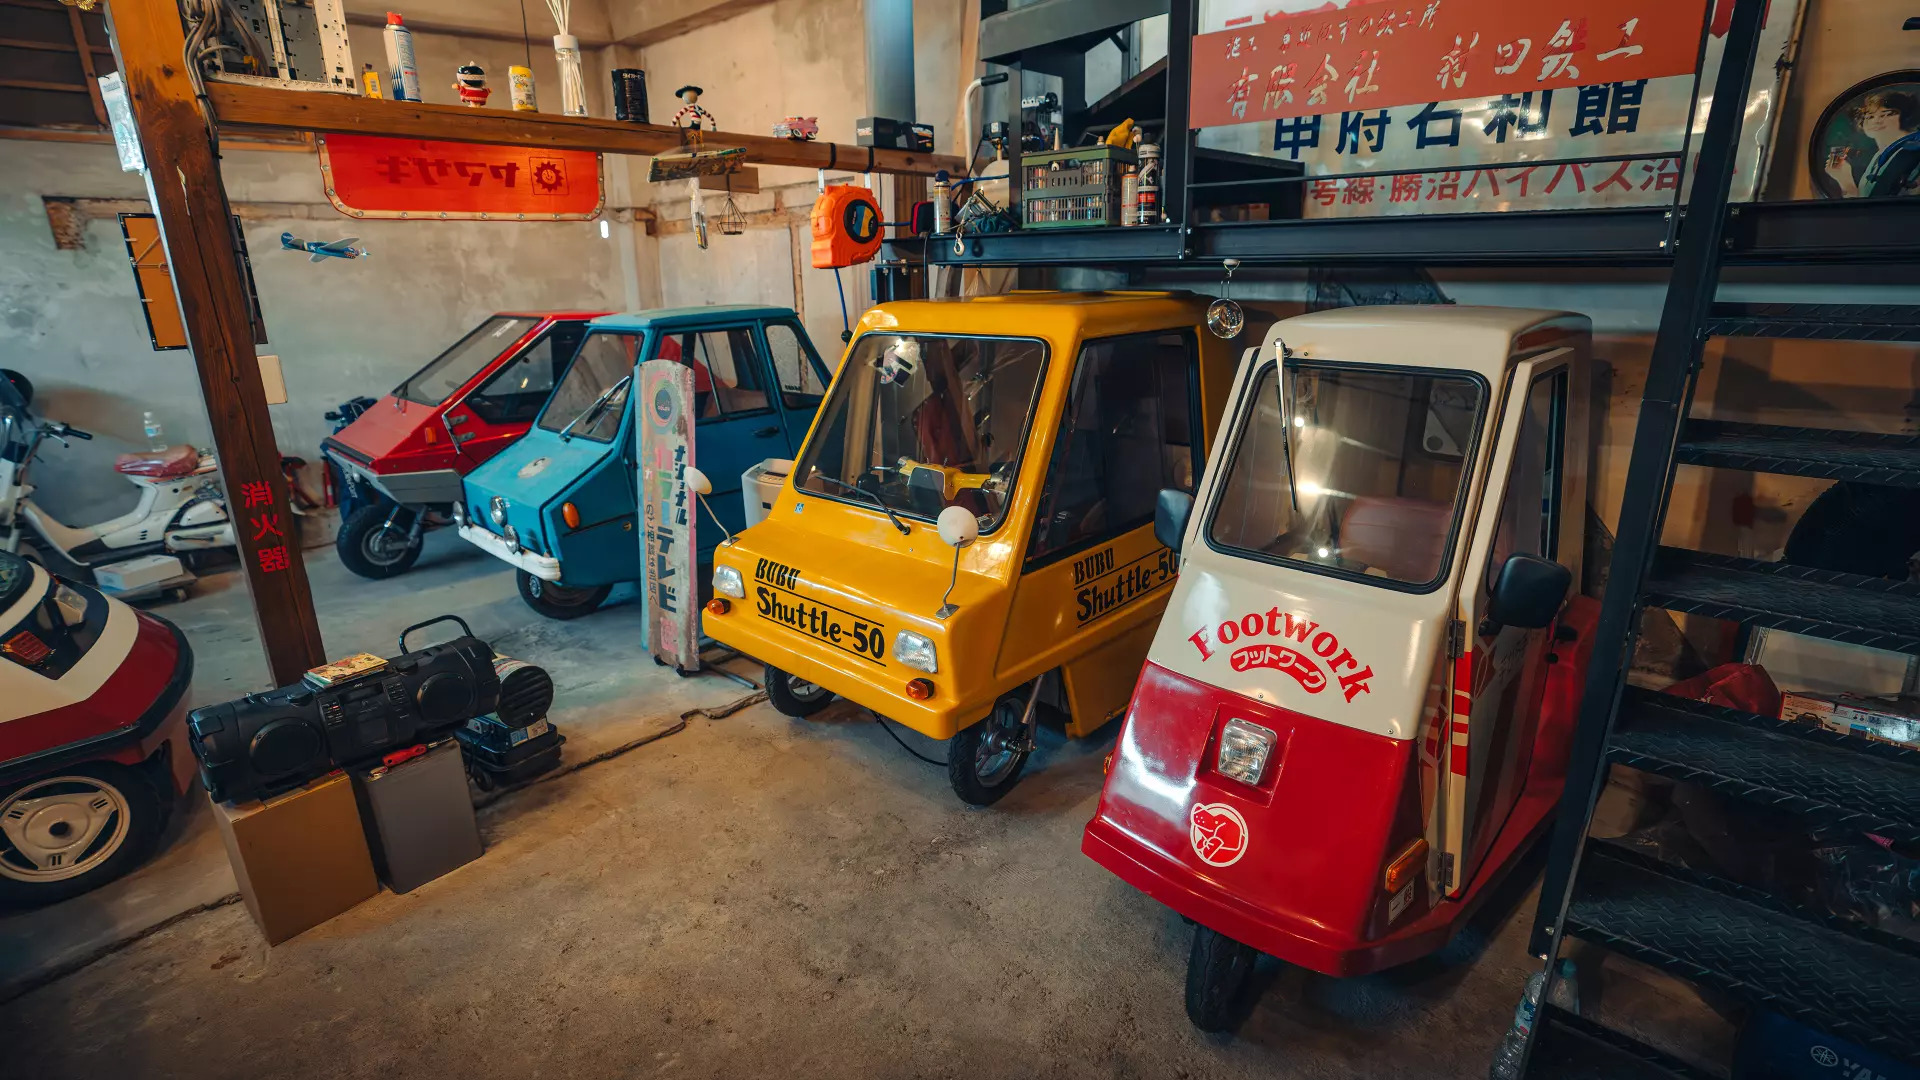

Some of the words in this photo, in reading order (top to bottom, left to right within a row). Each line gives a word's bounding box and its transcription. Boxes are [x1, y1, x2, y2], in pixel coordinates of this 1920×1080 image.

[1226, 50, 1380, 119] 有限会社
[1273, 79, 1648, 160] 甲府石和館
[240, 480, 290, 573] 消火器
[755, 557, 801, 590] BUBU
[1073, 547, 1115, 585] BUBU
[1076, 549, 1177, 622] Shuttle-50
[756, 585, 885, 659] Shuttle-50
[1187, 605, 1374, 704] Footwork
[1232, 646, 1326, 689] フットワーク
[1842, 1057, 1887, 1080] YA
